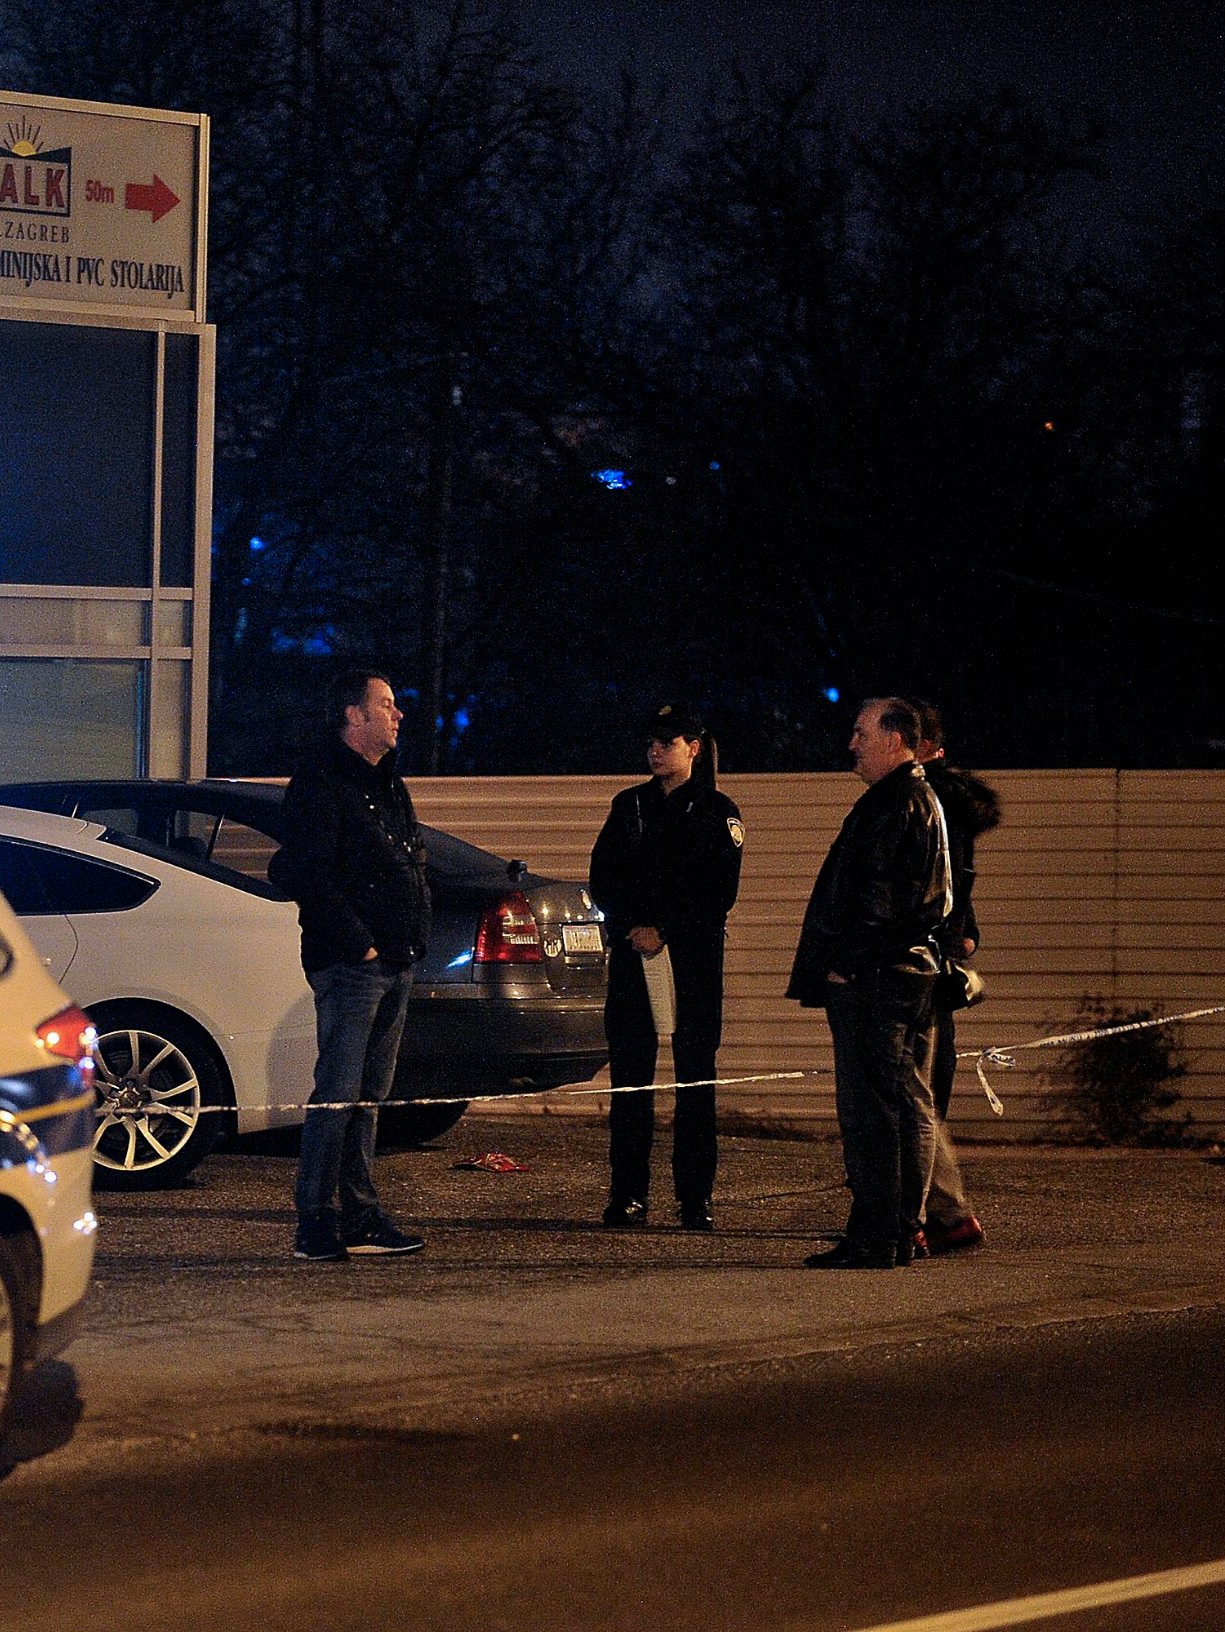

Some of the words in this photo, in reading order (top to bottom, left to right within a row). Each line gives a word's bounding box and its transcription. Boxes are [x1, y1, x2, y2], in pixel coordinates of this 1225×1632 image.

[85, 179, 115, 204] 50m
[5, 221, 70, 244] ZAGREB
[64, 257, 71, 283] I
[76, 257, 105, 288] PVC
[110, 259, 185, 299] STOLARIJA
